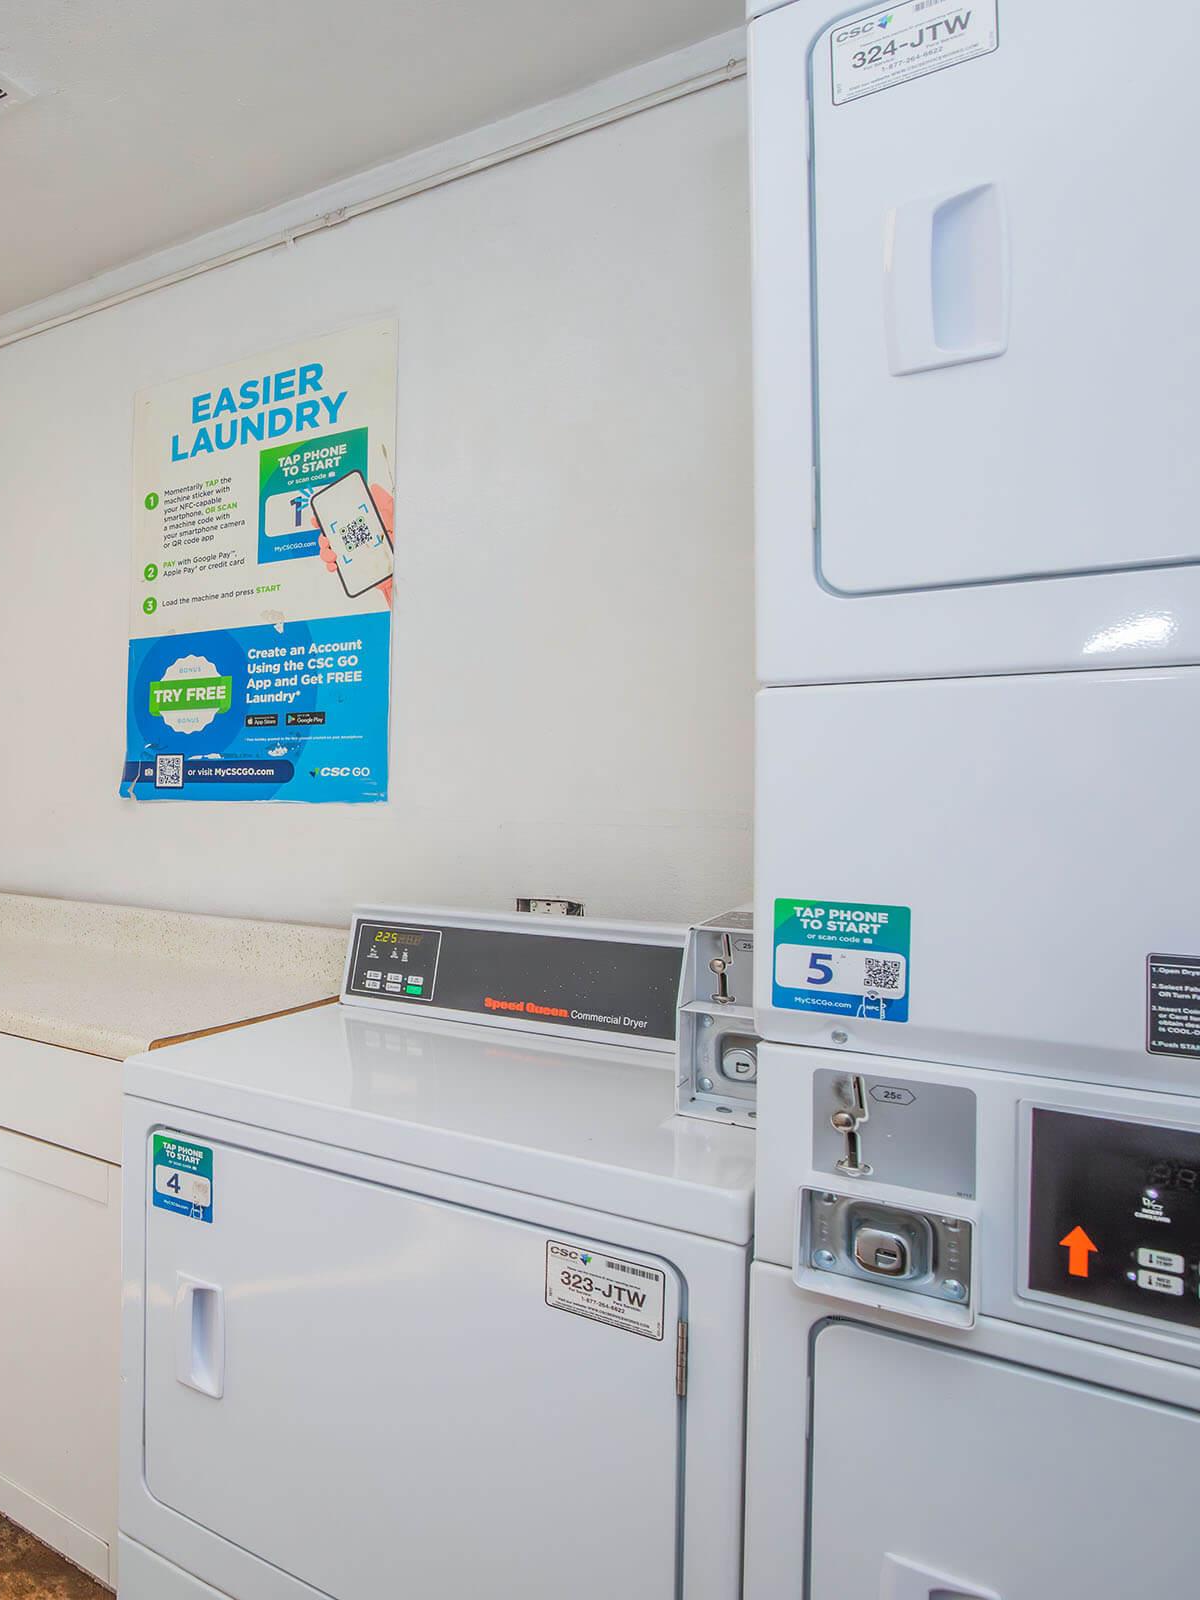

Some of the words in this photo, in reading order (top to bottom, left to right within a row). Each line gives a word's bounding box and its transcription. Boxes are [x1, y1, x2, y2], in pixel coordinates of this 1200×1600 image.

[836, 22, 874, 43] CSC
[851, 11, 971, 69] 324-JTW
[192, 363, 324, 424] EASIER
[172, 391, 347, 462] LAUNDRY
[278, 454, 301, 467] TAP
[304, 444, 347, 462] PHONE
[282, 466, 299, 477] TO
[302, 456, 342, 473] START
[164, 484, 203, 496] Momentarily
[205, 479, 219, 487] TAP
[164, 494, 190, 504] machine
[191, 490, 213, 499] sticker
[215, 486, 230, 494] with
[164, 506, 178, 515] your
[179, 497, 222, 510] NFC-capable
[164, 511, 204, 523] smartphone,
[217, 502, 238, 511] SCAN
[290, 496, 302, 527] 1
[163, 533, 178, 541] your
[179, 524, 218, 537] smartphone
[220, 519, 245, 529] camera
[169, 521, 195, 530] machine
[197, 516, 214, 525] code
[215, 513, 231, 521] with
[171, 539, 182, 547] QR
[183, 536, 200, 545] code
[201, 534, 214, 543] app
[274, 541, 317, 552] MyCSCGO.com
[163, 560, 176, 568] PAY
[177, 558, 191, 566] with
[193, 554, 217, 564] Google
[163, 569, 182, 577] Apple
[208, 561, 228, 570] credit
[229, 558, 245, 567] card
[148, 567, 155, 578] 2
[162, 599, 178, 607] Load
[179, 596, 190, 604] the
[191, 593, 219, 602] machine
[220, 591, 234, 599] and
[235, 588, 254, 597] press
[256, 584, 281, 593] START
[146, 600, 153, 611] 3
[248, 646, 287, 659] Create
[290, 646, 305, 655] an
[308, 640, 362, 654] Account
[179, 666, 201, 674] BONUS
[247, 662, 280, 674] Using
[284, 660, 304, 672] the
[307, 657, 334, 669] CSC
[337, 655, 358, 667] GO
[246, 678, 272, 690] App
[274, 675, 298, 686] and
[301, 673, 323, 685] Get
[326, 670, 363, 683] FREE
[153, 688, 183, 703] TRY
[186, 685, 226, 701] FREE
[177, 717, 199, 725] BONUS
[187, 768, 196, 776] or
[197, 767, 213, 775] visit
[214, 767, 275, 777] MyCSCGO.com
[320, 767, 350, 777] CSC
[352, 767, 370, 777] GO
[793, 906, 825, 918] TAP
[829, 909, 888, 924] PHONE
[800, 918, 822, 930] TO
[826, 920, 881, 935] START
[374, 931, 398, 943] 2.25
[839, 935, 860, 943] code
[806, 953, 833, 985] 5
[1158, 967, 1180, 975] Open
[1159, 983, 1183, 991] Select
[794, 996, 852, 1009] MyCSCGo.com
[1158, 1005, 1182, 1013] Insert
[484, 997, 524, 1012] Speed
[525, 1002, 569, 1018] Queen
[570, 1010, 621, 1025] Commercial
[623, 1016, 648, 1029] Dryer
[1169, 1013, 1188, 1021] Card
[1158, 1040, 1179, 1048] Push
[162, 1142, 176, 1151] TAP
[177, 1145, 203, 1159] PHONE
[165, 1150, 176, 1158] TO
[177, 1153, 201, 1165] START
[166, 1173, 181, 1194] 4
[550, 1246, 579, 1260] CSC
[560, 1270, 647, 1309] 323-JTW
